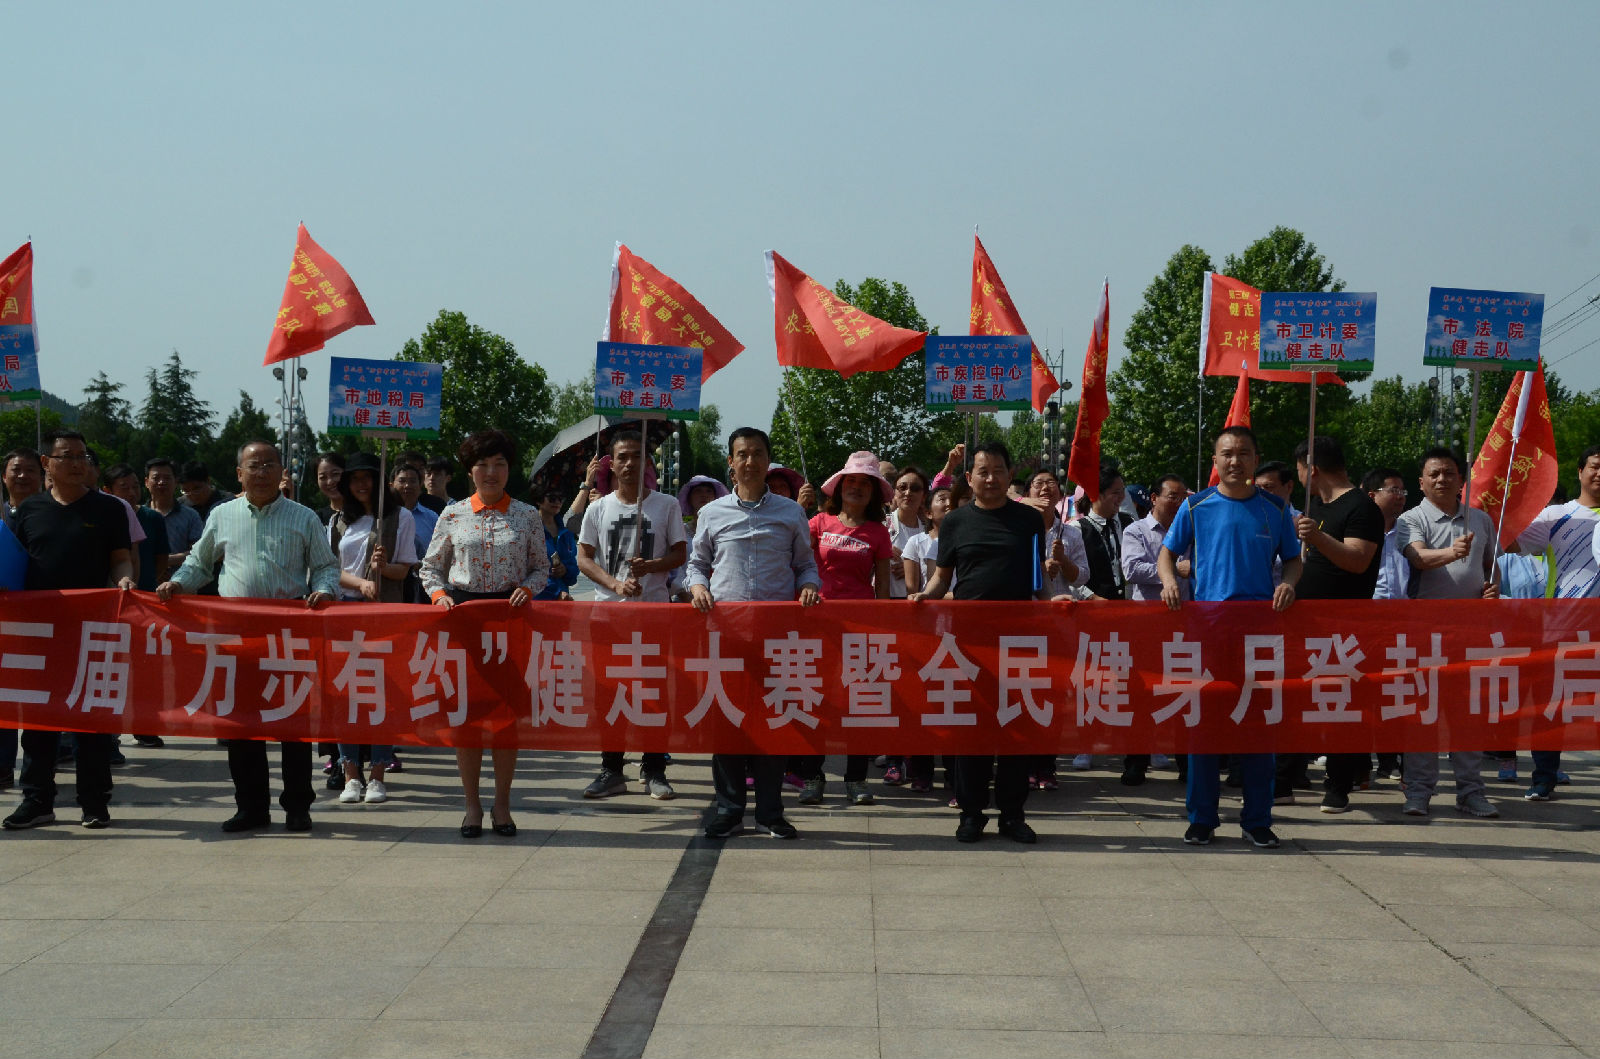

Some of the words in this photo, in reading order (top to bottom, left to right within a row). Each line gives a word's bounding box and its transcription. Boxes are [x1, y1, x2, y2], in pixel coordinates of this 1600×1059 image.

[1276, 322, 1359, 340] 市卫计委
[1443, 318, 1525, 339] 市法院
[1286, 343, 1346, 360] 健走队
[1452, 339, 1511, 358] 健走队
[611, 369, 687, 391] 市农委
[935, 364, 1022, 381] 市疾控中心
[344, 388, 425, 409] 市地税局
[619, 390, 675, 409] 健走队
[952, 383, 1007, 400] 健走队
[354, 407, 413, 427] 健走队
